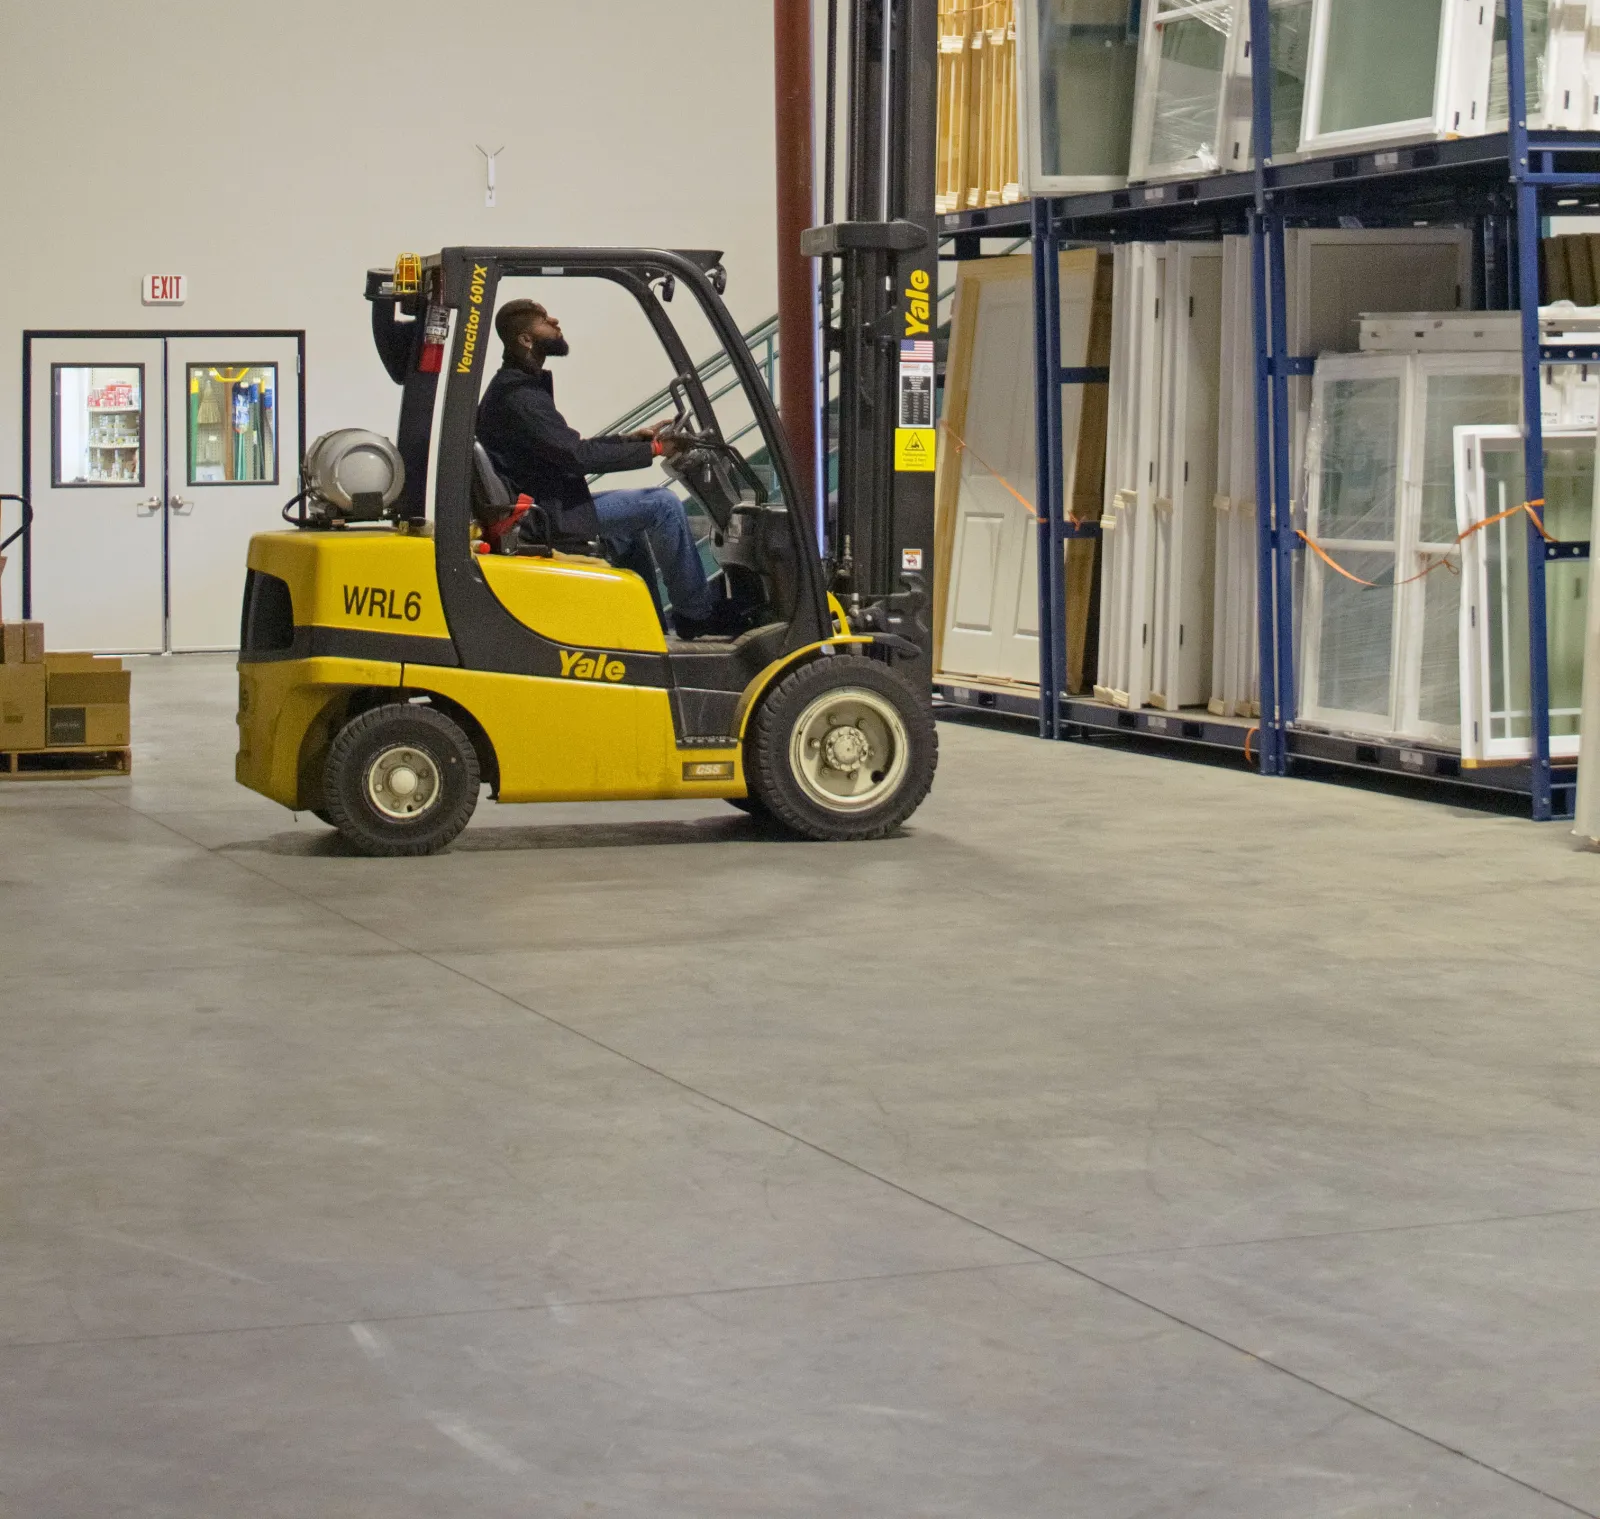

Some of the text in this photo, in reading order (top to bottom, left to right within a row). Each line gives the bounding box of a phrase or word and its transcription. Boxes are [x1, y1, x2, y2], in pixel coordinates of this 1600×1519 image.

[151, 275, 182, 299] EXIT
[905, 269, 930, 337] Yale
[457, 263, 488, 374] Veracitor 60VX
[343, 584, 422, 622] WRL6
[559, 650, 627, 681] Yale
